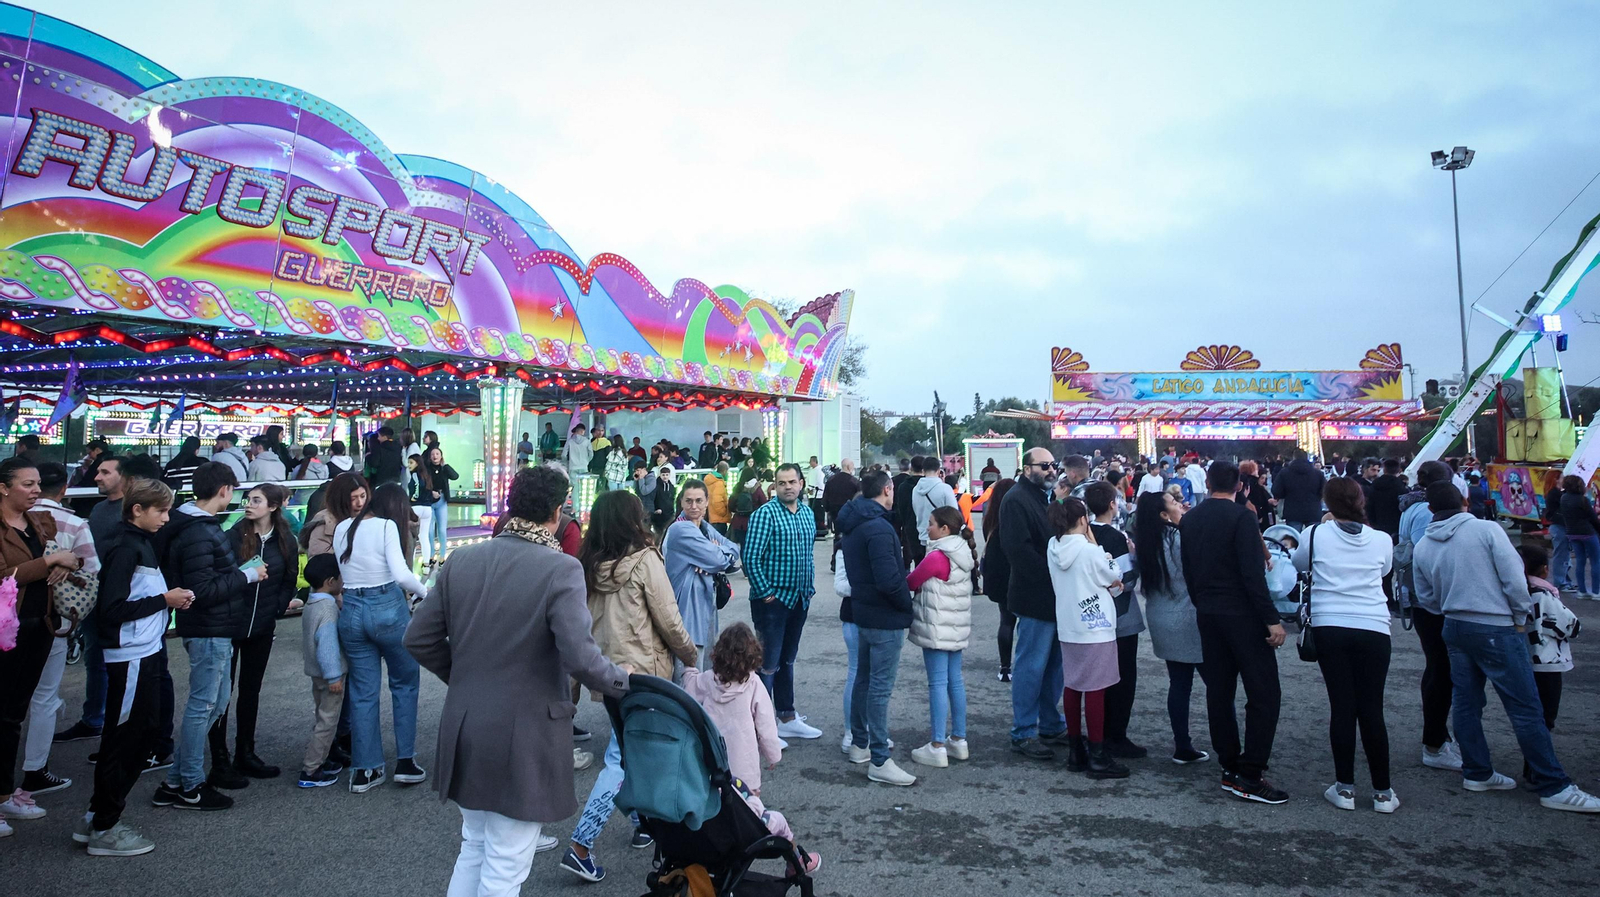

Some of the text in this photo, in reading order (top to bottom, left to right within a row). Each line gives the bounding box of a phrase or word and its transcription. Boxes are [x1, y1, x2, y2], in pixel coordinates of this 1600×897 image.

[12, 107, 492, 283] AUTOSPORT
[275, 249, 453, 313] GUERRERO
[1083, 603, 1101, 618] TRIP
